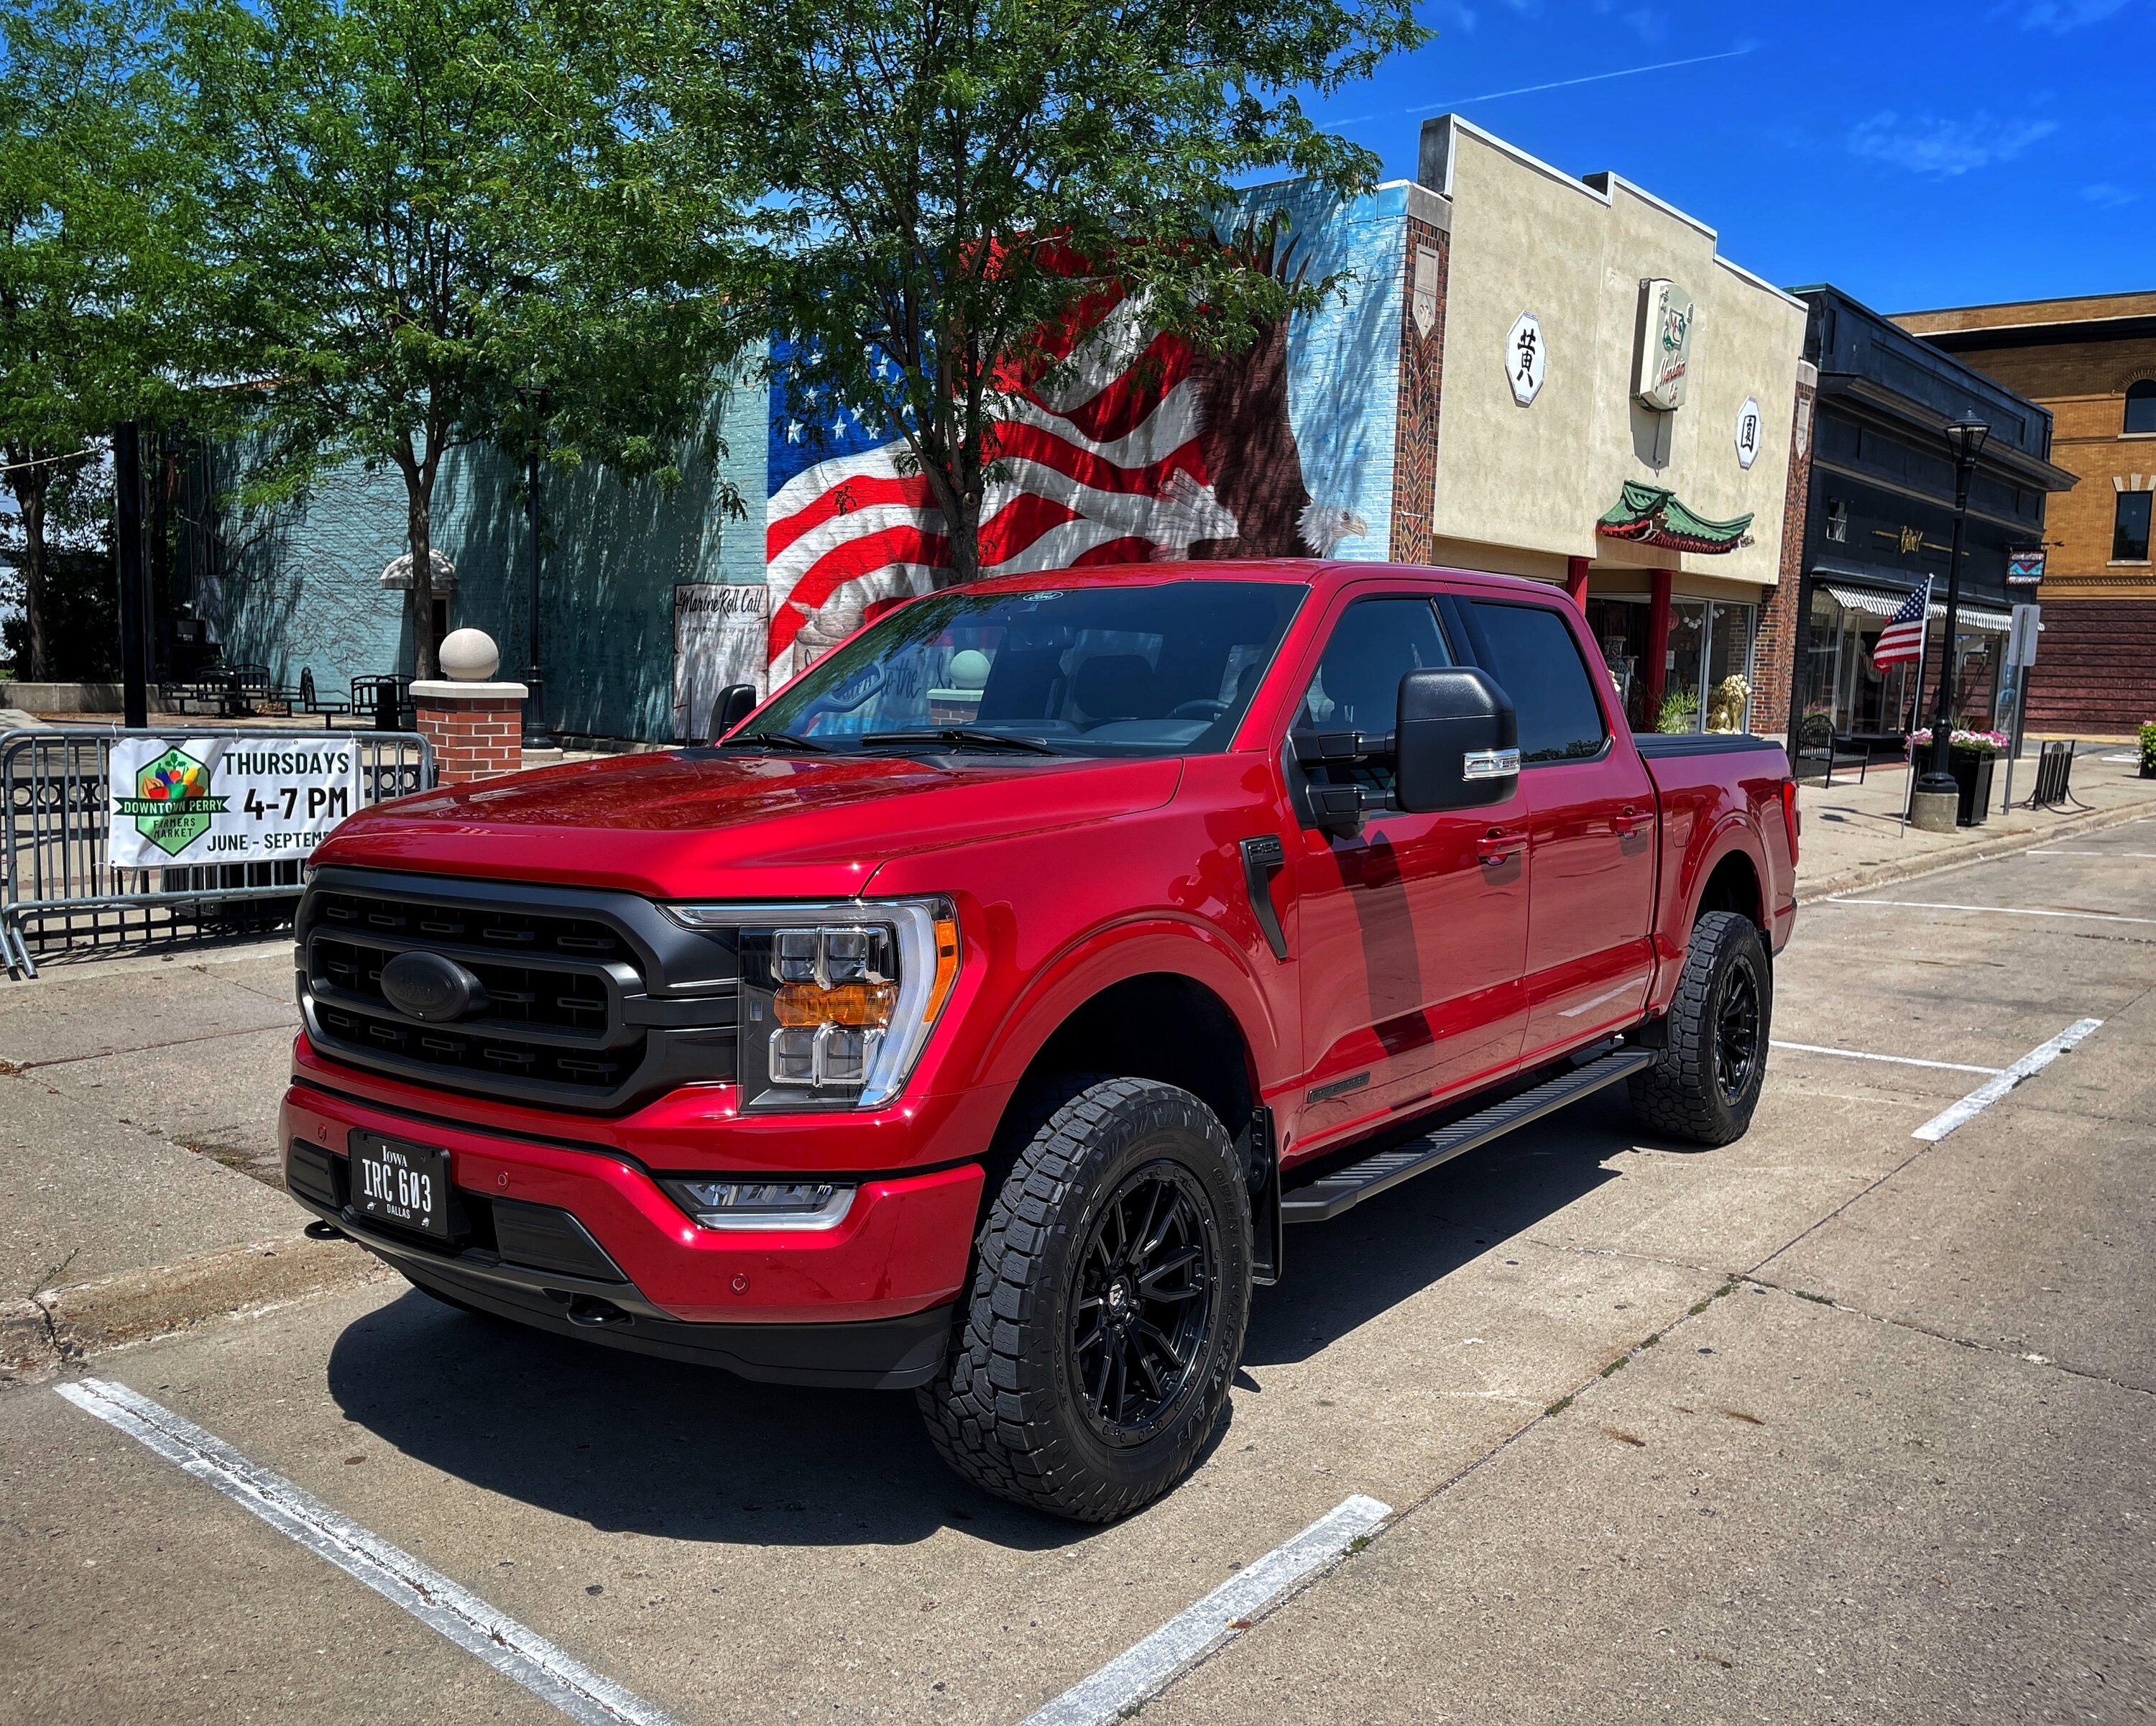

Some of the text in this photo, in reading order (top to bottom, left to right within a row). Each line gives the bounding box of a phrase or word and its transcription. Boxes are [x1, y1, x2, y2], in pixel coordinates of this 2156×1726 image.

[680, 589, 763, 620] Marine Roll Call
[222, 751, 349, 776] THURSDAYS
[123, 798, 224, 814] DOWNTOWN PERRY
[244, 787, 348, 821] 4-7 PM
[153, 817, 196, 829] FARMERS
[153, 827, 194, 839] MARKET
[207, 834, 249, 852] JUNE
[361, 1158, 431, 1213] IRC 603
[387, 1203, 410, 1219] DALLAS
